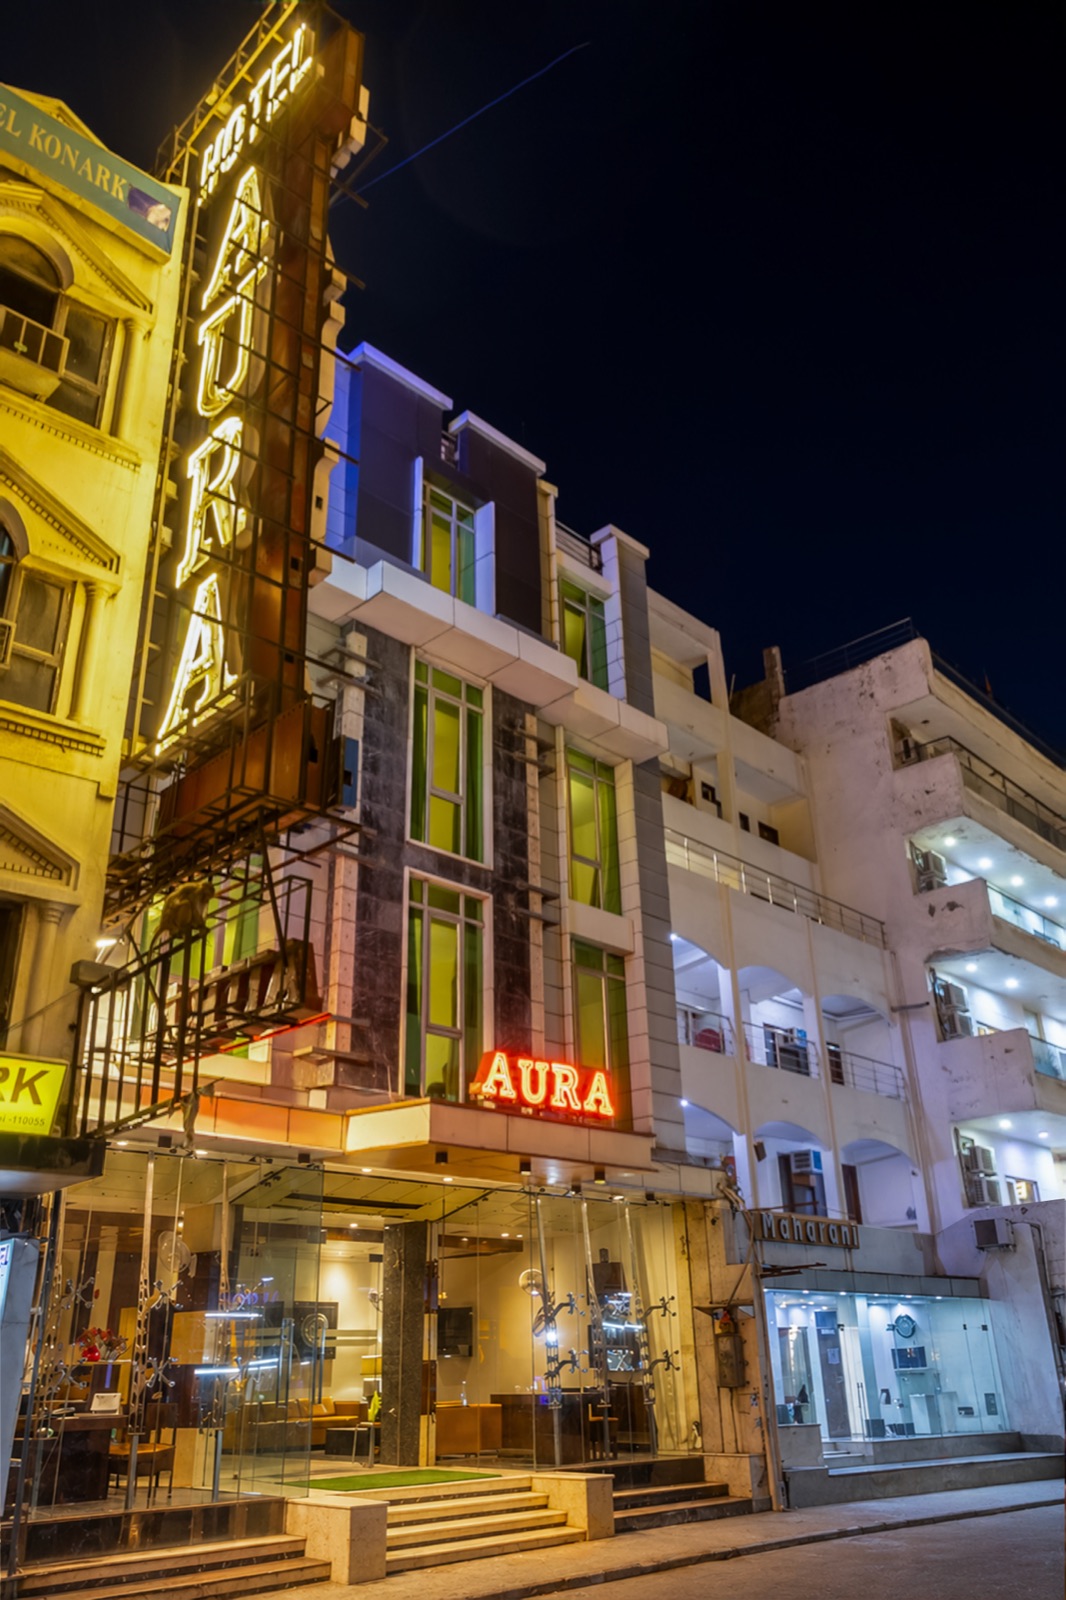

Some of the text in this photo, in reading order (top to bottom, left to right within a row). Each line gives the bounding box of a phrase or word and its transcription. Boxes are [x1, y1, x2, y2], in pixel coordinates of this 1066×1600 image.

[196, 22, 313, 207] HOTEL
[28, 123, 128, 202] KONARK
[154, 165, 270, 757] AURA
[481, 1051, 615, 1117] AURA
[762, 1211, 858, 1247] Maharani
